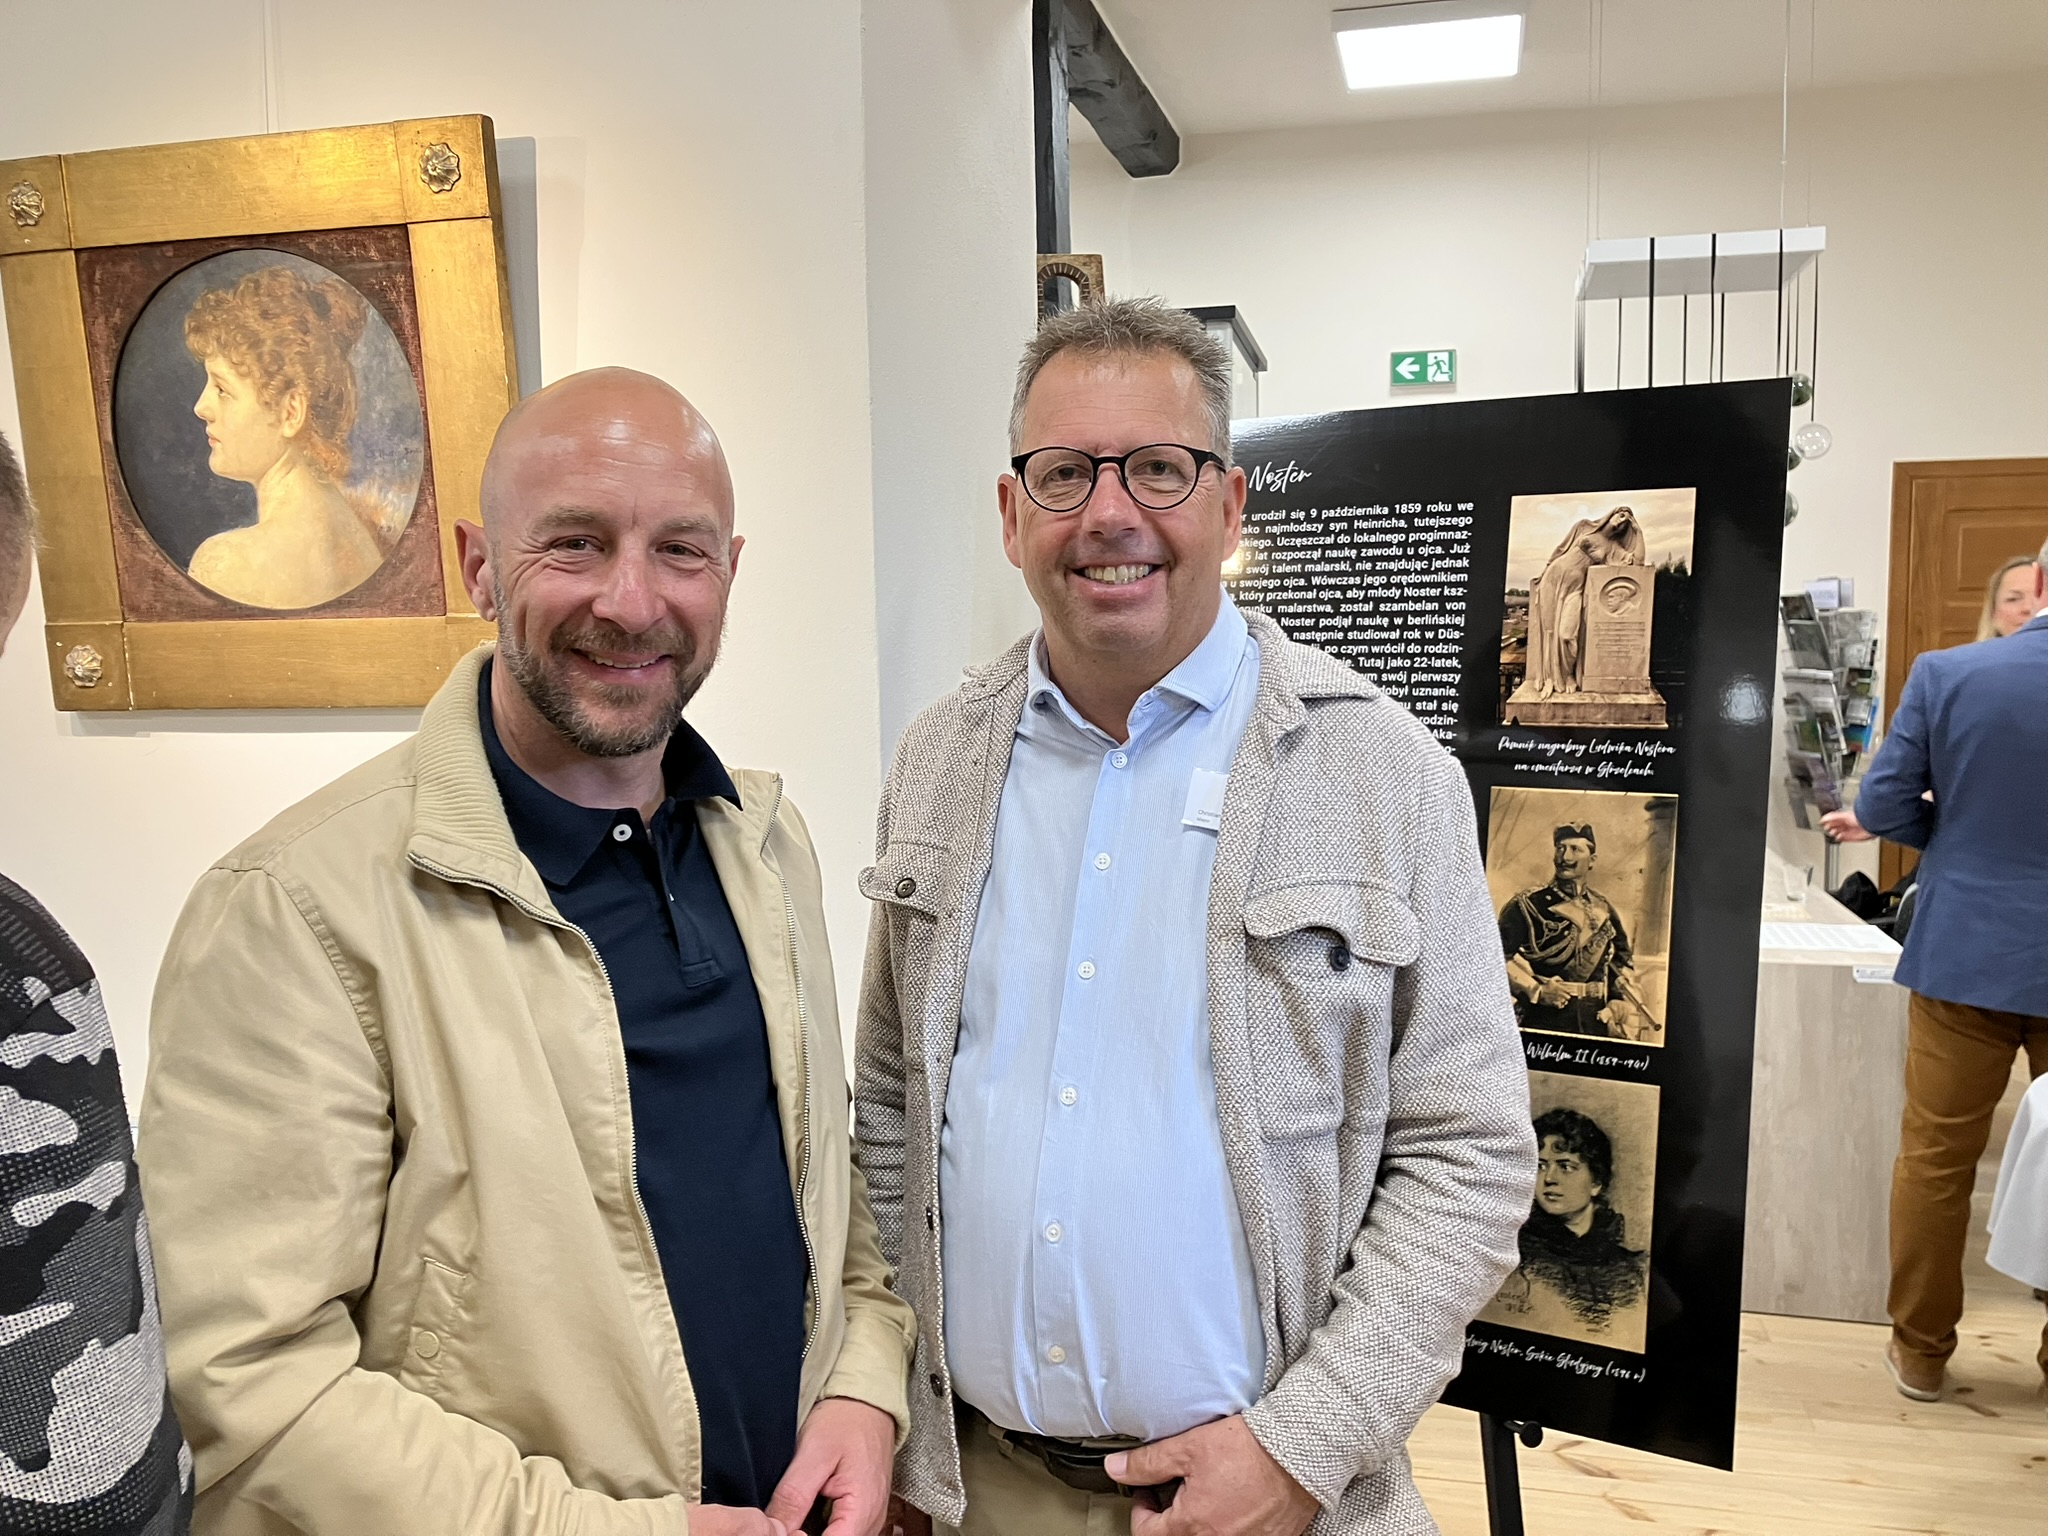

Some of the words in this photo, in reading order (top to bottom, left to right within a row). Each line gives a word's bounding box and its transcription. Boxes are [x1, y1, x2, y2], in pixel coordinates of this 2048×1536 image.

[1248, 460, 1313, 494] Noster
[1251, 509, 1286, 521] urodził
[1290, 508, 1305, 521] się
[1310, 508, 1317, 518] 9
[1321, 504, 1389, 520] października
[1394, 503, 1422, 514] 1859
[1426, 501, 1452, 512] roku
[1457, 502, 1474, 511] we
[1241, 524, 1260, 535] ako
[1265, 522, 1323, 535] najmłodszy
[1329, 522, 1348, 532] syn
[1353, 517, 1408, 529] Heinricha,
[1414, 516, 1473, 528] tutejszego
[1239, 538, 1274, 549] skiego.
[1276, 534, 1334, 548] Uczęszczał
[1337, 533, 1351, 544] do
[1353, 532, 1406, 544] lokalnego
[1409, 530, 1472, 543] progimnaz-
[1255, 551, 1268, 560] lat
[1271, 548, 1321, 561] rozpoczął
[1325, 547, 1357, 559] naukę
[1360, 545, 1403, 557] zawodu
[1407, 546, 1414, 555] u
[1418, 543, 1445, 557] ojca.
[1449, 542, 1471, 554] Już
[1246, 564, 1269, 575] swój
[1272, 563, 1302, 573] talent
[1304, 561, 1352, 573] malarski,
[1355, 560, 1372, 571] nie
[1375, 558, 1429, 572] znajdując
[1431, 556, 1469, 571] jednak
[1239, 578, 1280, 589] swojego
[1283, 577, 1308, 589] ojca.
[1311, 575, 1361, 586] Wówczas
[1362, 574, 1387, 587] jego
[1390, 571, 1468, 586] orędownikiem
[1239, 590, 1264, 602] który
[1266, 588, 1316, 602] przekonał
[1319, 588, 1344, 601] ojca,
[1346, 587, 1365, 600] aby
[1367, 586, 1401, 599] młody
[1403, 586, 1441, 597] Noster
[1443, 585, 1468, 596] ksz-
[1278, 603, 1334, 613] malarstwa,
[1339, 601, 1373, 612] został
[1379, 600, 1439, 612] szambelan
[1445, 601, 1466, 611] von
[1280, 616, 1316, 627] Noster
[1319, 615, 1352, 628] podjął
[1356, 615, 1389, 628] naukę
[1393, 617, 1403, 625] w
[1407, 614, 1465, 627] berlińskiej
[1293, 630, 1344, 642] następnie
[1347, 628, 1400, 640] studiował
[1403, 628, 1421, 639] rok
[1425, 630, 1434, 639] w
[1438, 628, 1464, 639] Düs-
[1324, 645, 1338, 654] po
[1340, 645, 1368, 656] czym
[1371, 642, 1405, 653] wrócił
[1407, 642, 1421, 653] do
[1424, 642, 1463, 653] rodzin-
[1358, 656, 1384, 669] Tutaj
[1386, 656, 1411, 669] jako
[1413, 656, 1462, 668] 22-latek,
[1381, 671, 1407, 683] swój
[1411, 671, 1461, 684] pierwszy
[1380, 685, 1409, 698] dobył
[1412, 685, 1459, 696] uznanie.
[1415, 699, 1437, 710] stał
[1441, 700, 1459, 713] się
[1538, 739, 1587, 757] nagrobny
[1589, 738, 1634, 754] Ludwika
[1635, 740, 1677, 758] Nostera
[1527, 1042, 1573, 1062] Wilhelm
[1572, 1049, 1589, 1063] II
